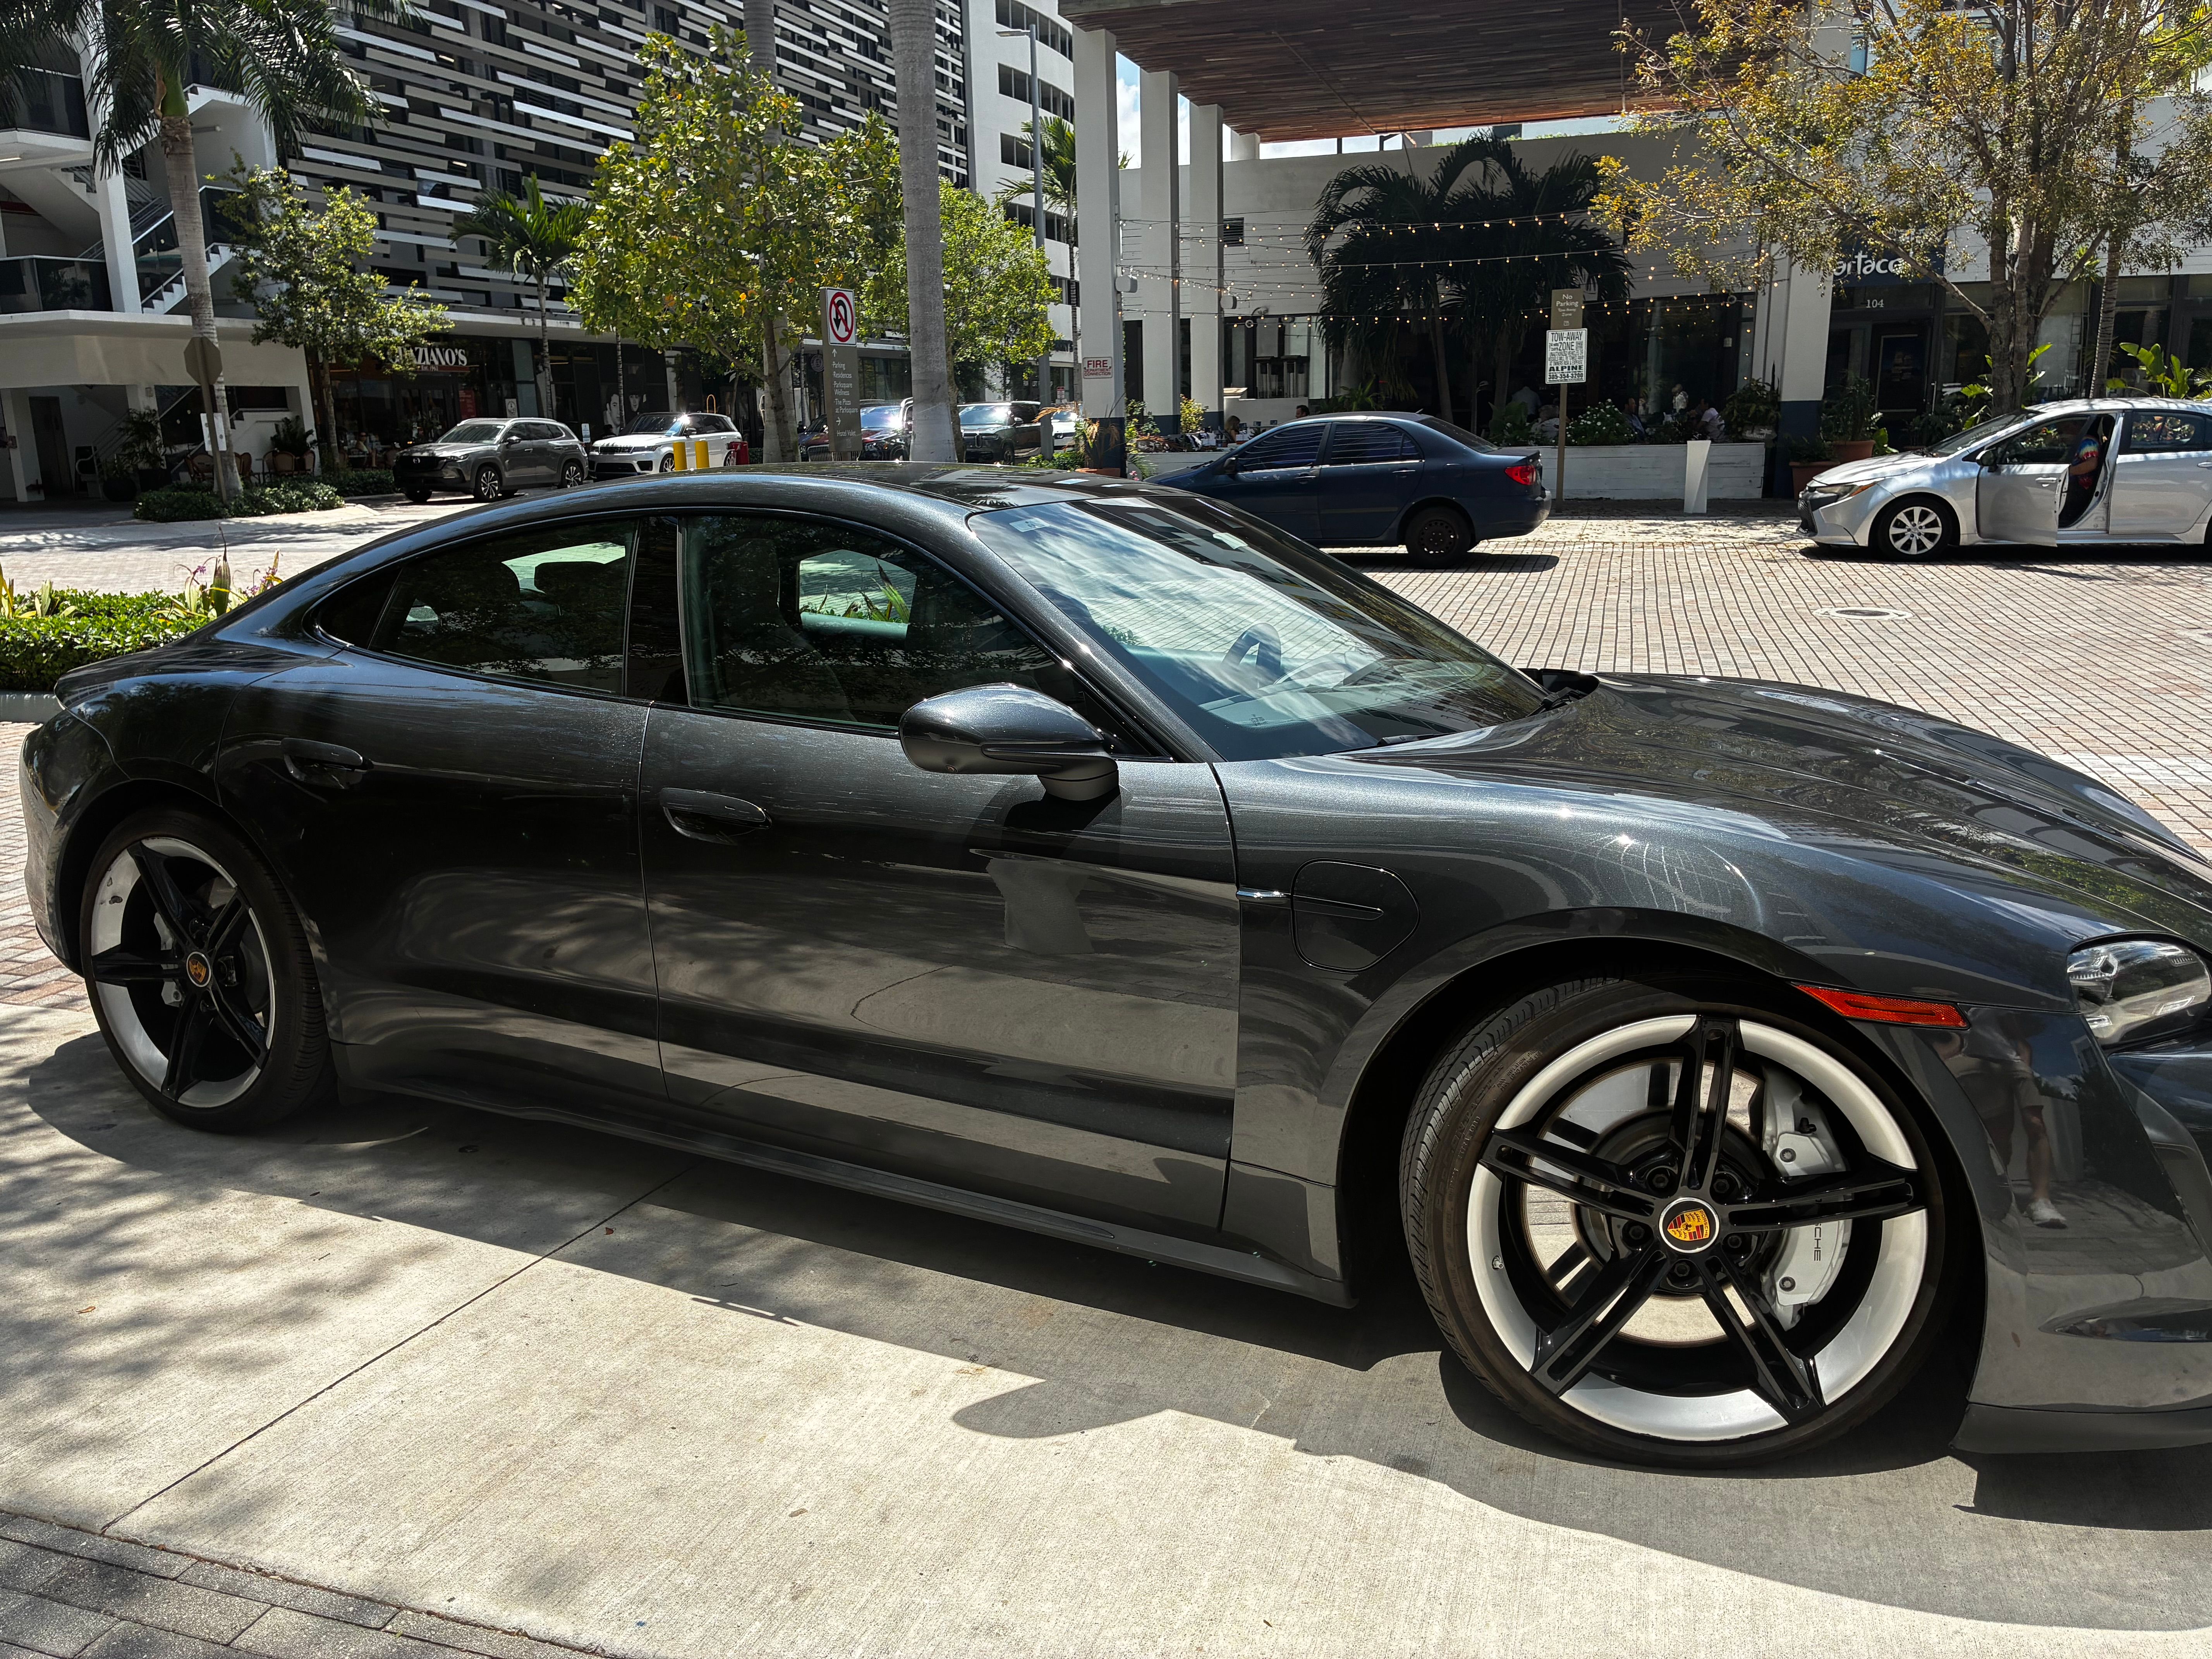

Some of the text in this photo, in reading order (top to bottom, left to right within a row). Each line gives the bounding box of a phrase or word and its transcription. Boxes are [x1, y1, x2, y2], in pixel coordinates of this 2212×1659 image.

[1866, 299, 1884, 308] 104
[1551, 331, 1583, 342] TOW-AWAY
[1559, 341, 1574, 350] ZONE
[832, 361, 845, 370] Parking
[1700, 1210, 1708, 1238] PORSCHE
